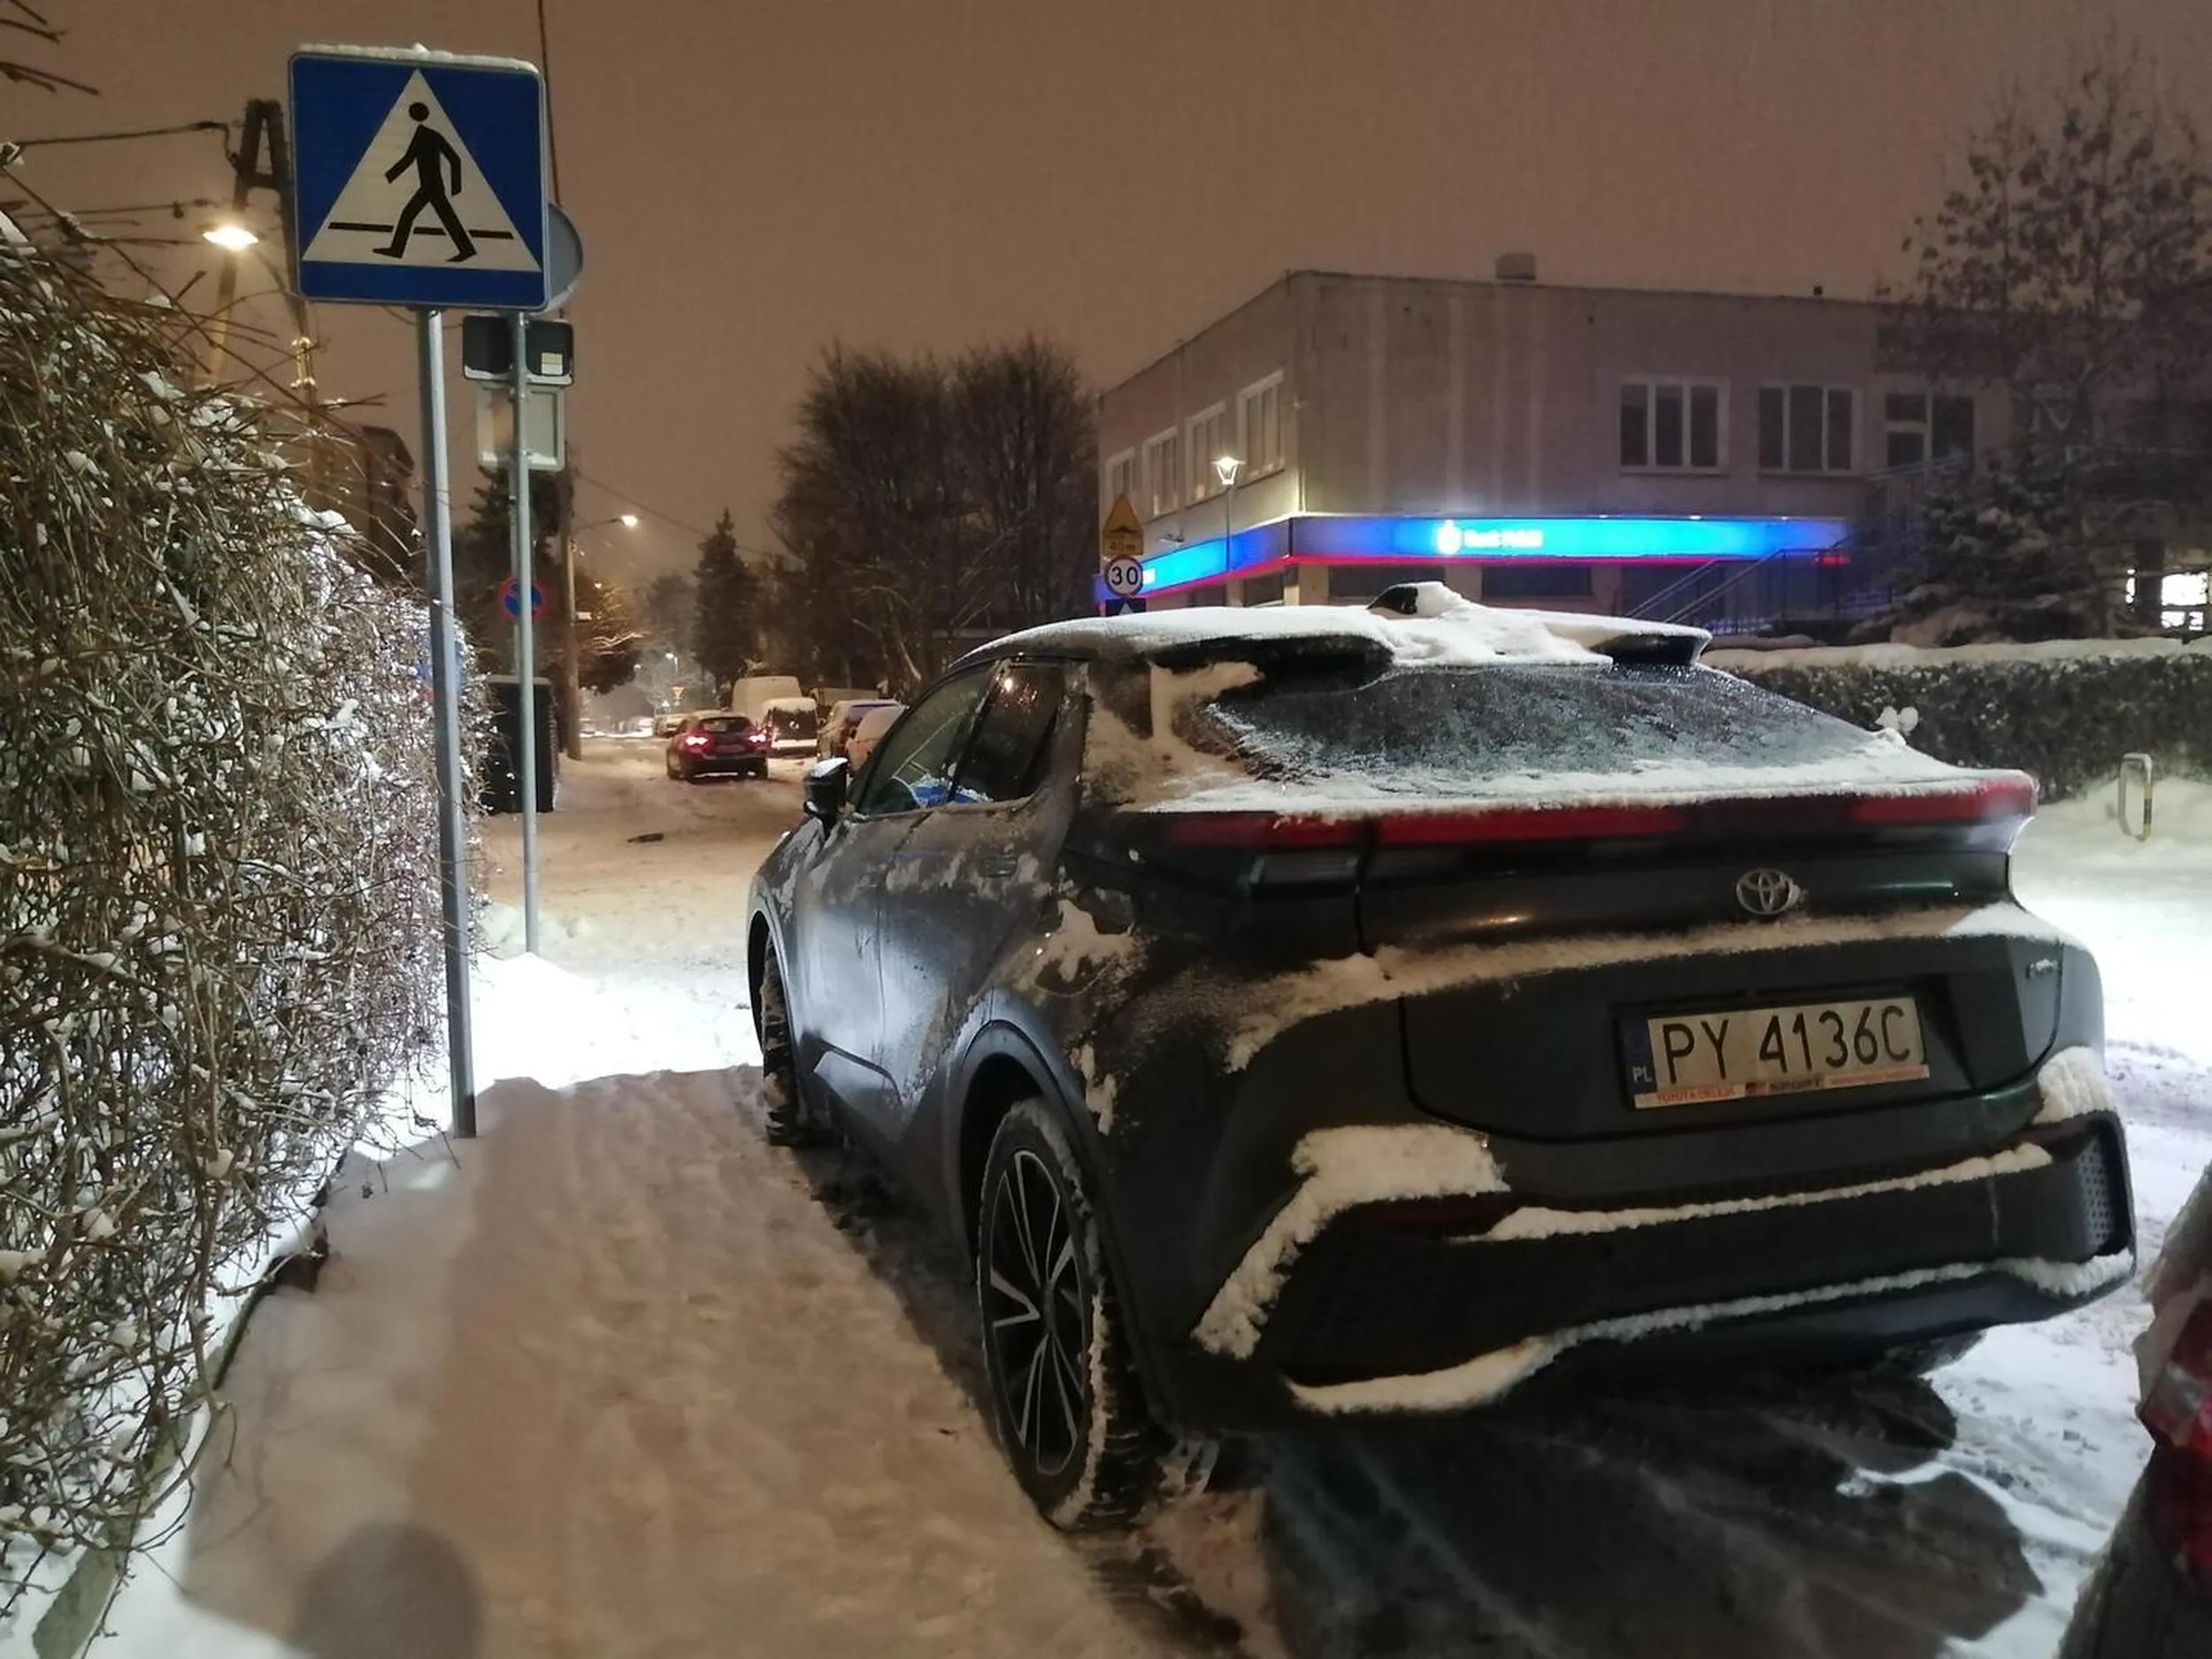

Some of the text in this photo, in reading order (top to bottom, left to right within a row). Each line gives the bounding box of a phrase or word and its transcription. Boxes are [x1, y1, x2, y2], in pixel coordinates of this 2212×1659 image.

[1111, 566, 1139, 586] 30
[1662, 1005, 1910, 1085] PY 4136C
[1632, 1065, 1653, 1083] PL
